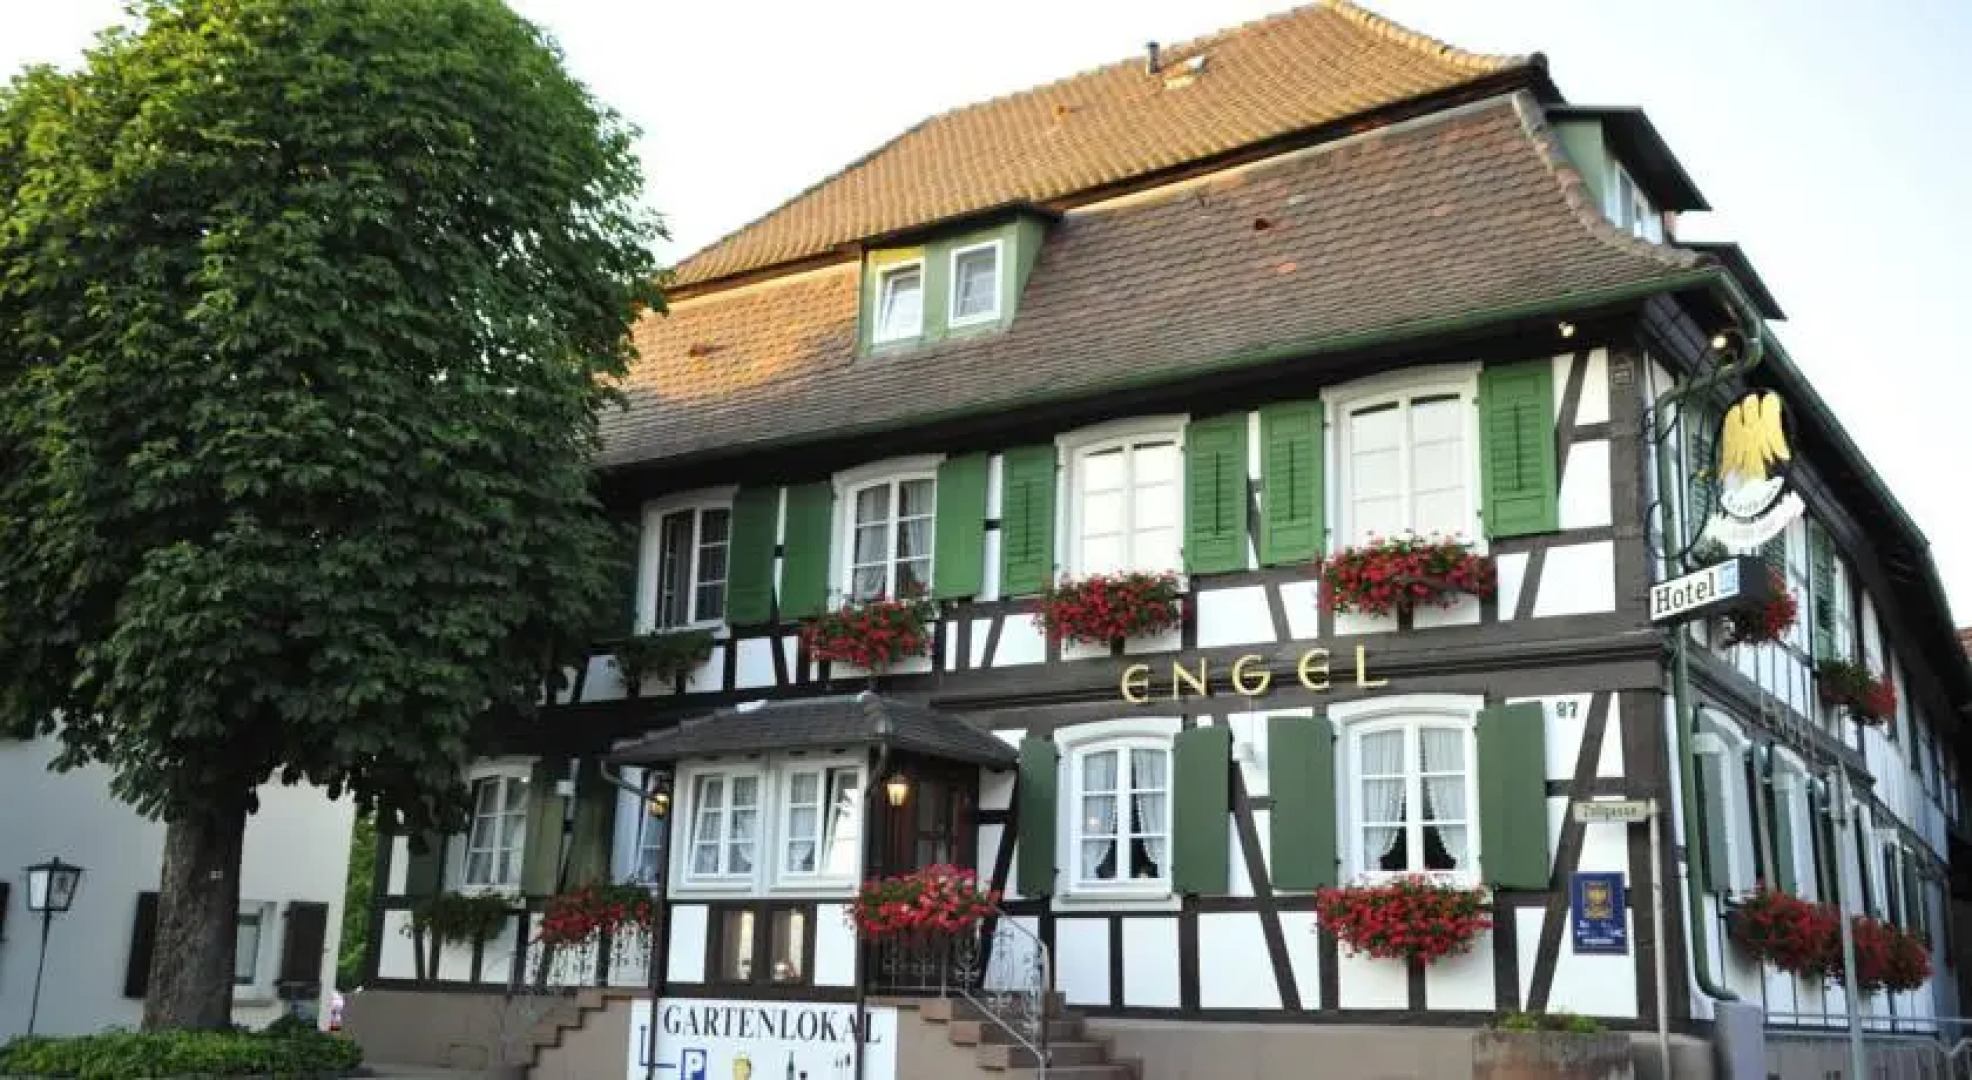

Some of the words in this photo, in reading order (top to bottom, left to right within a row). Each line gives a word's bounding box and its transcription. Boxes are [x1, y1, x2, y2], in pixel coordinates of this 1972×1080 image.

[1655, 572, 1716, 614] Hotel
[1120, 645, 1389, 703] ENGEL
[663, 1005, 882, 1044] GARTENLOKAL
